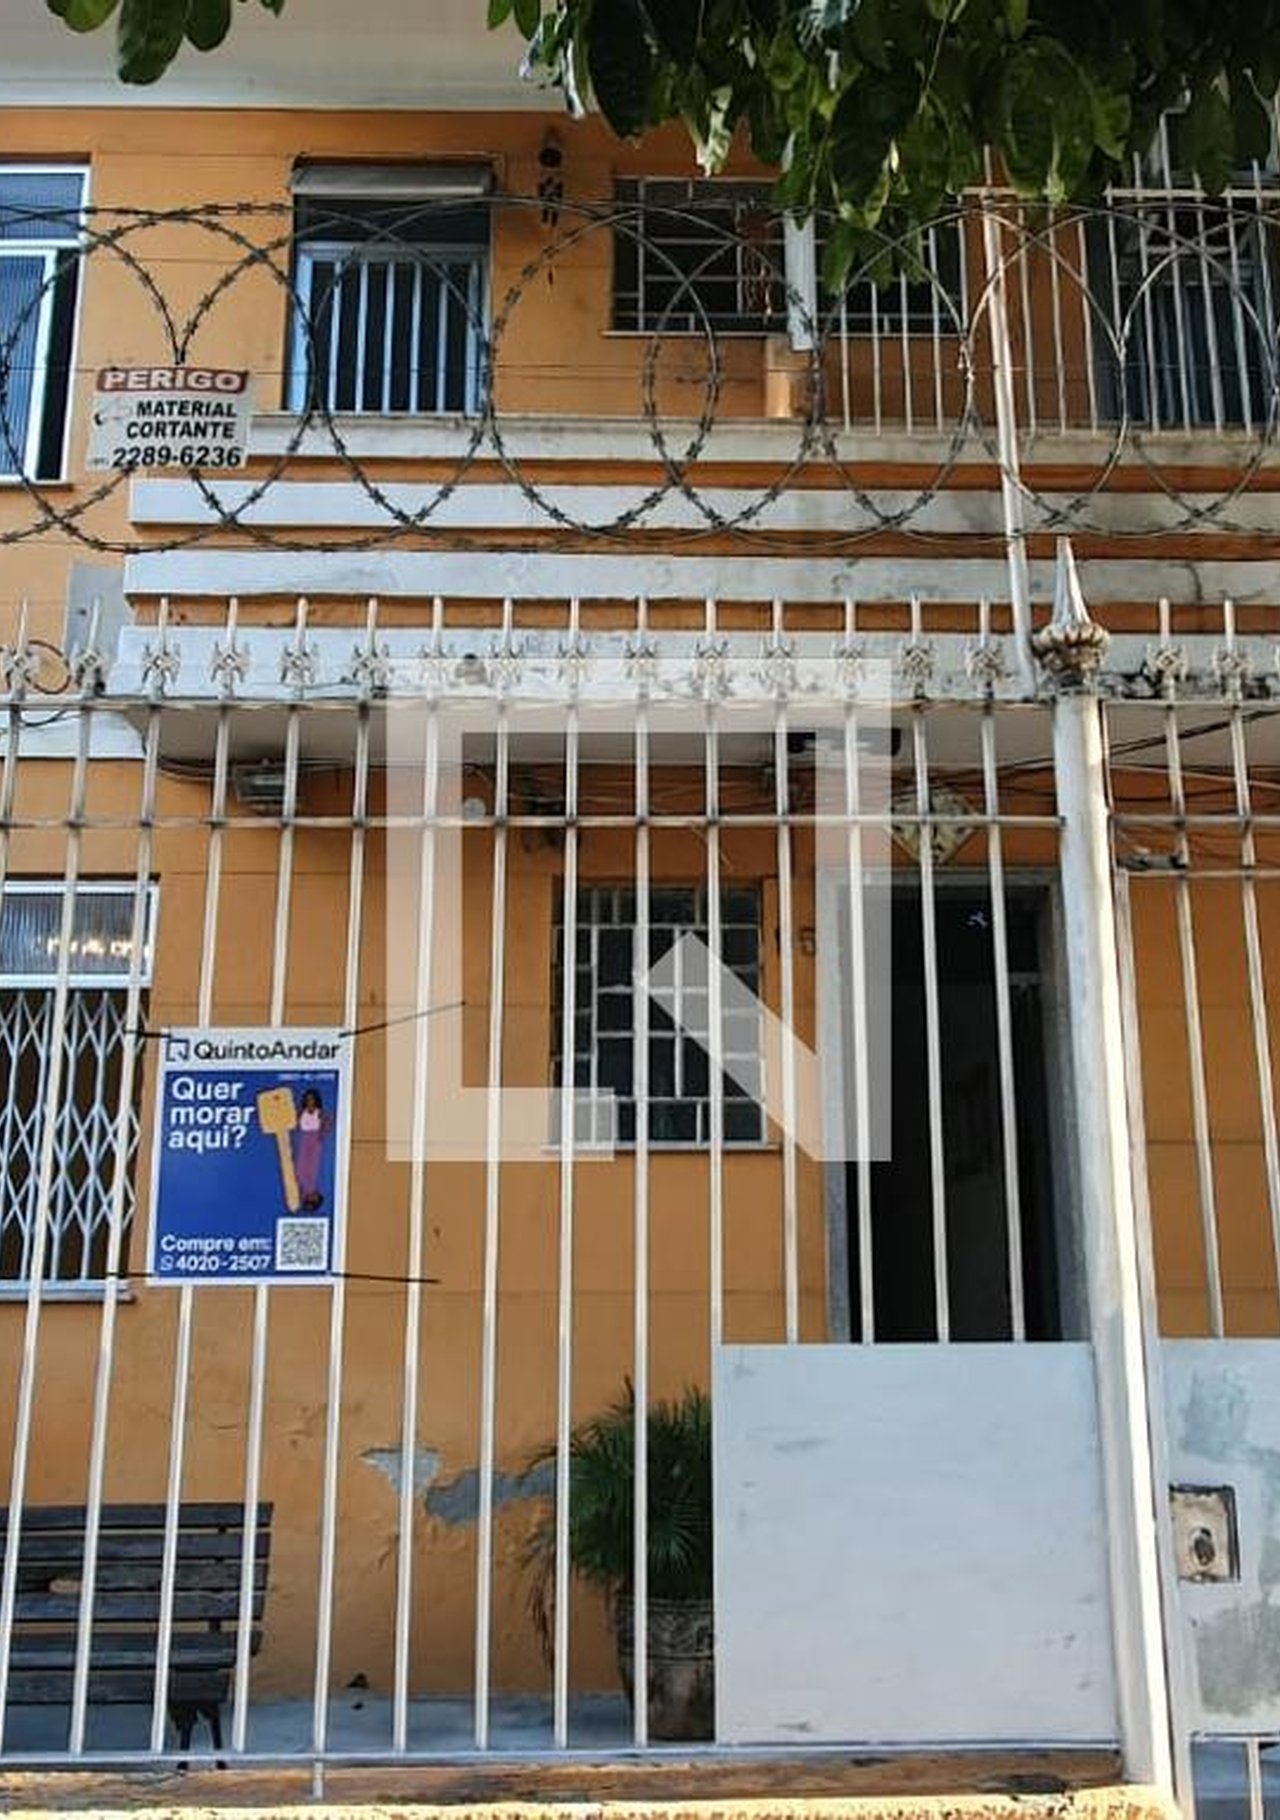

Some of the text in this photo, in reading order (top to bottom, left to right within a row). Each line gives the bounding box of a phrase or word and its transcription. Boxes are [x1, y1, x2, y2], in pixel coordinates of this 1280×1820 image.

[103, 370, 242, 391] PERIGO
[136, 400, 238, 418] MATERIAL
[126, 421, 235, 439] CORTANTE
[112, 446, 242, 469] 2289-6236
[194, 1040, 341, 1060] QuintoAndar
[172, 1077, 244, 1101] Quer
[170, 1106, 256, 1126] morar
[168, 1126, 247, 1154] aqui?
[161, 1234, 235, 1254] Compre
[176, 1255, 271, 1271] 4020-2507
